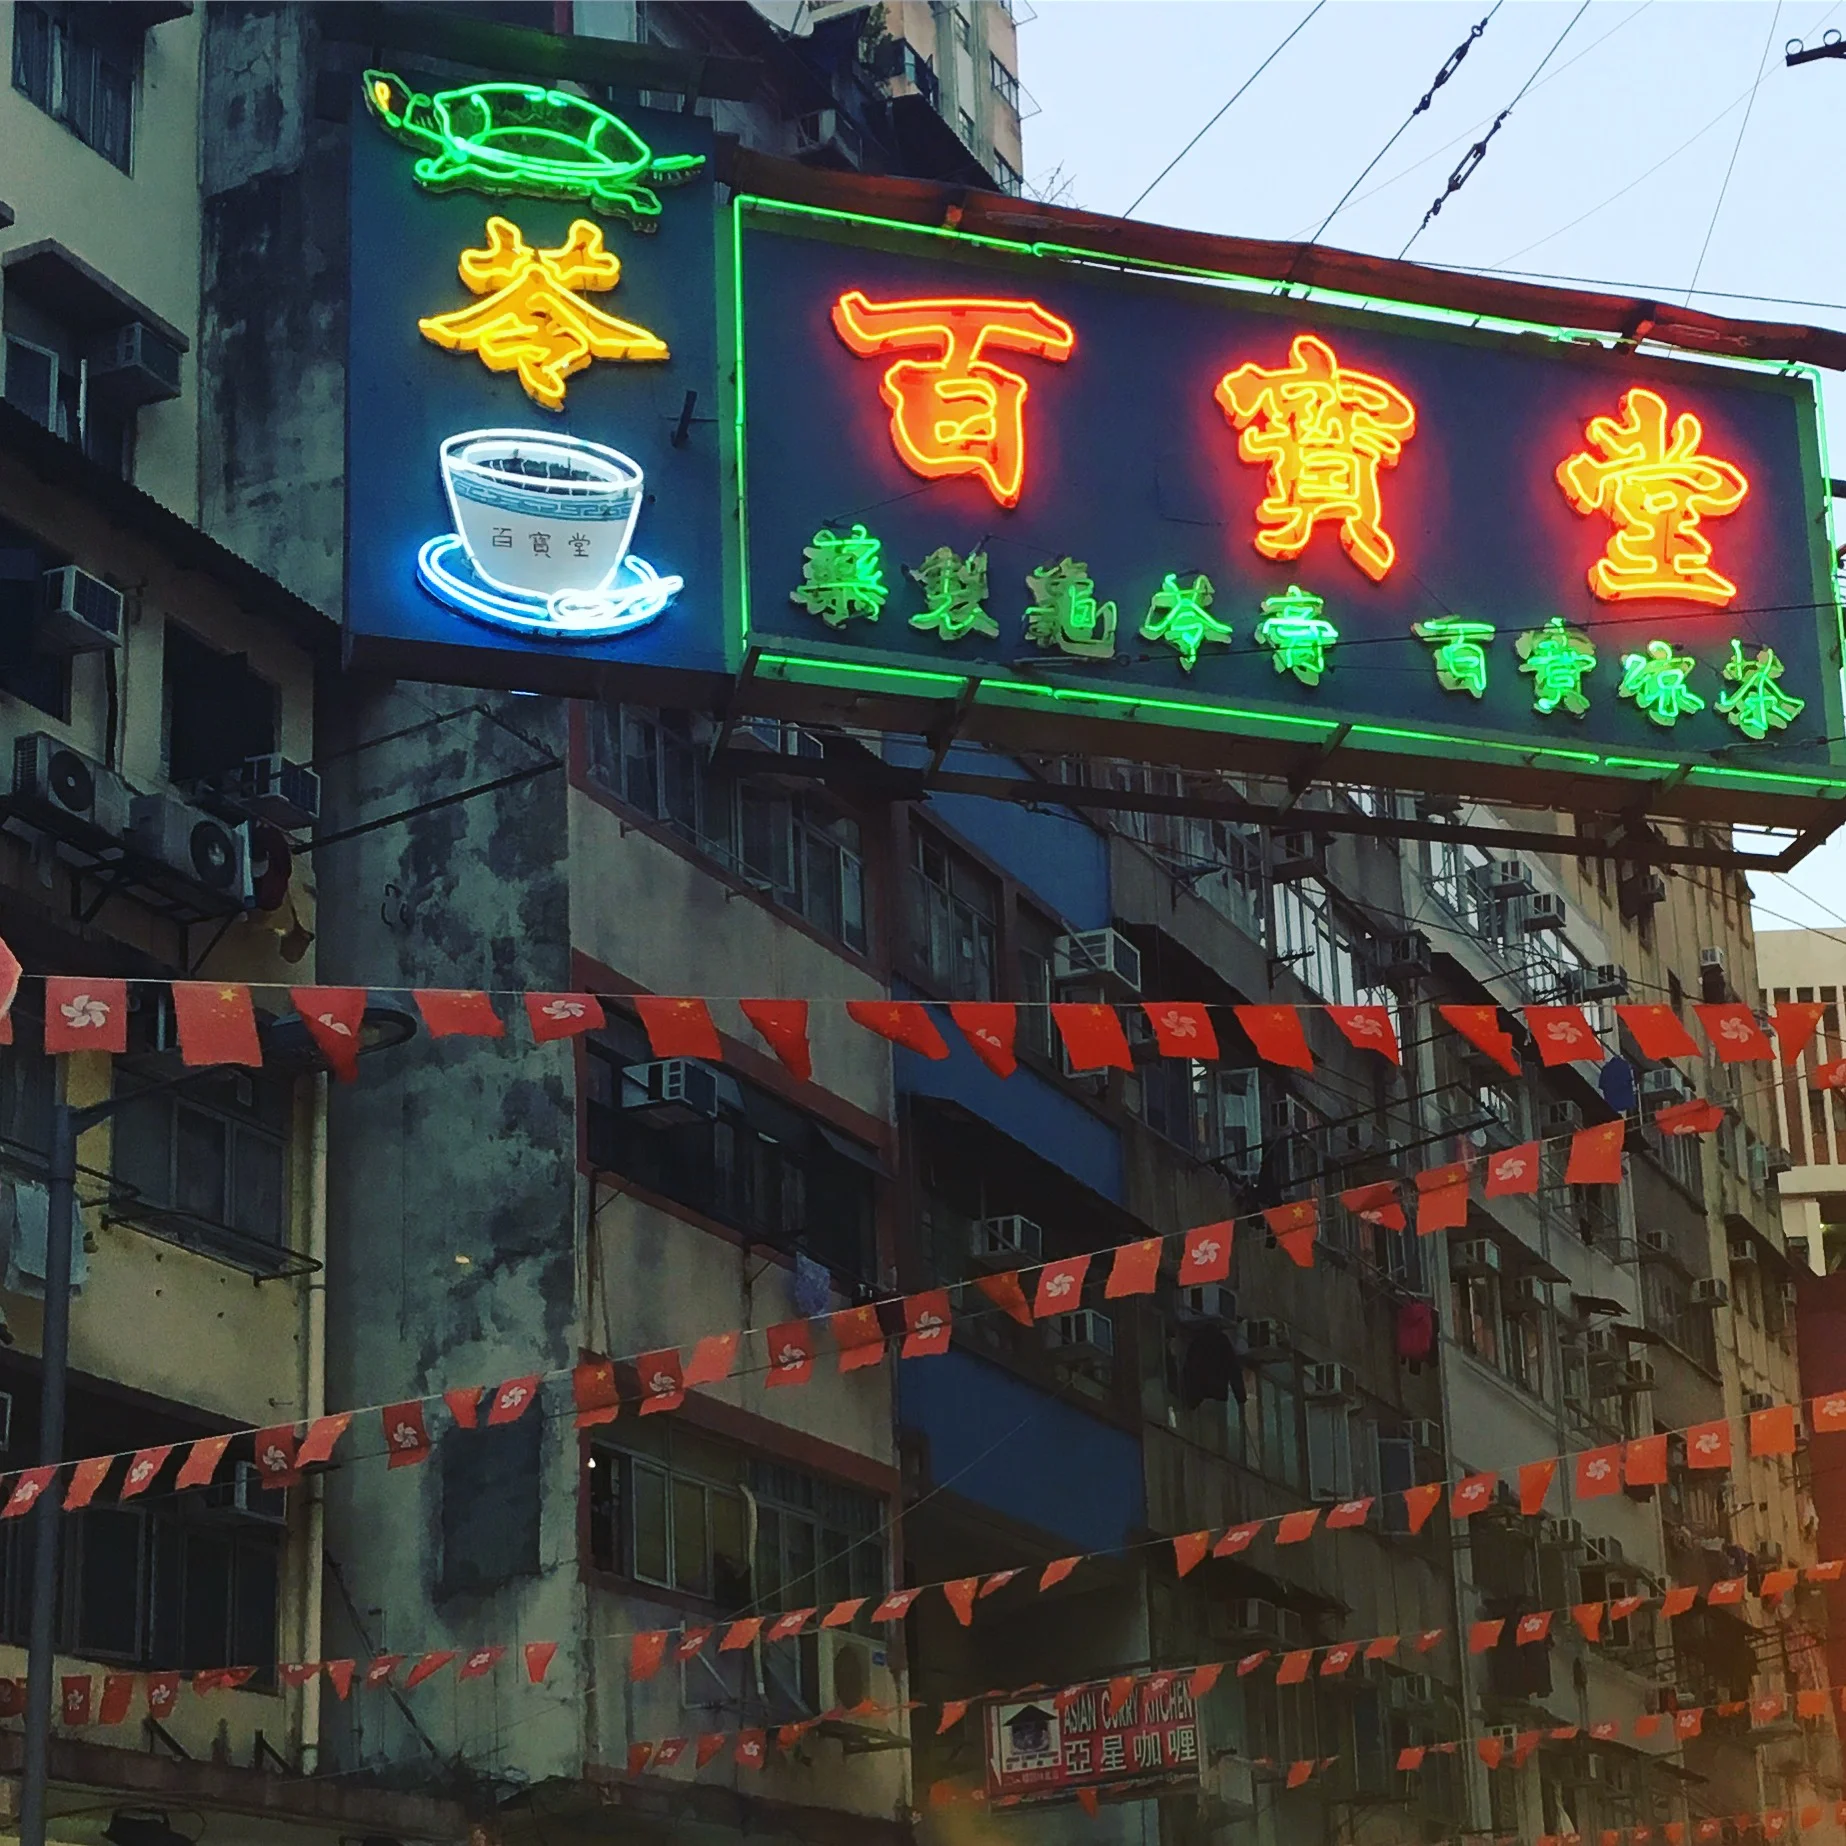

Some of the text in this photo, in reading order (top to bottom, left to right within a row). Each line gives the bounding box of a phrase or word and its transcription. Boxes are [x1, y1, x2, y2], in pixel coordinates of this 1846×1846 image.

[832, 290, 1750, 605] 百寶堂
[492, 527, 590, 559] 百寶堂
[1063, 1690, 1097, 1735] ASIAN
[1064, 1724, 1198, 1776] 亞星咖喱
